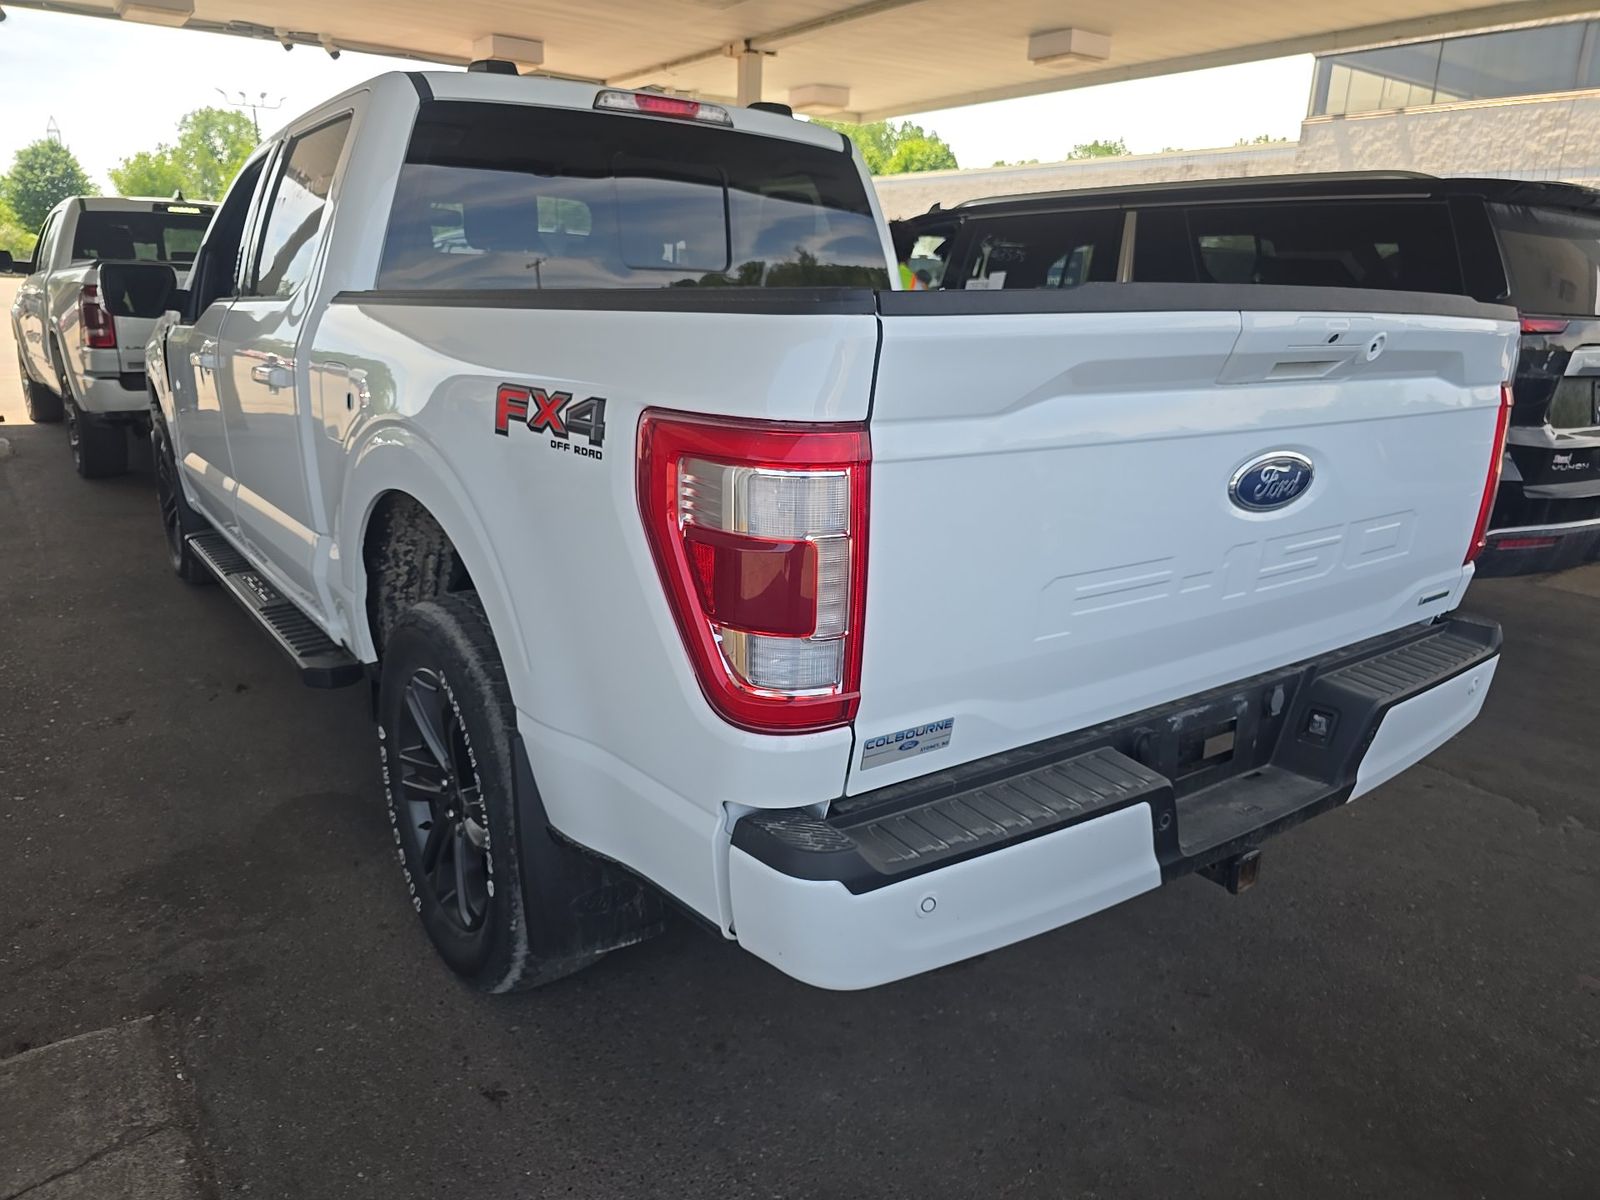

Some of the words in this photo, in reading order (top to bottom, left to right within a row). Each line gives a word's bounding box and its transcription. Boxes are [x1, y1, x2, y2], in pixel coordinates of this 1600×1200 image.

[495, 383, 607, 448] FX4
[550, 440, 571, 452] OFF
[574, 445, 603, 461] ROAD
[1254, 465, 1302, 499] Ford
[1034, 508, 1419, 642] F-150
[866, 720, 953, 750] COLBOURNE
